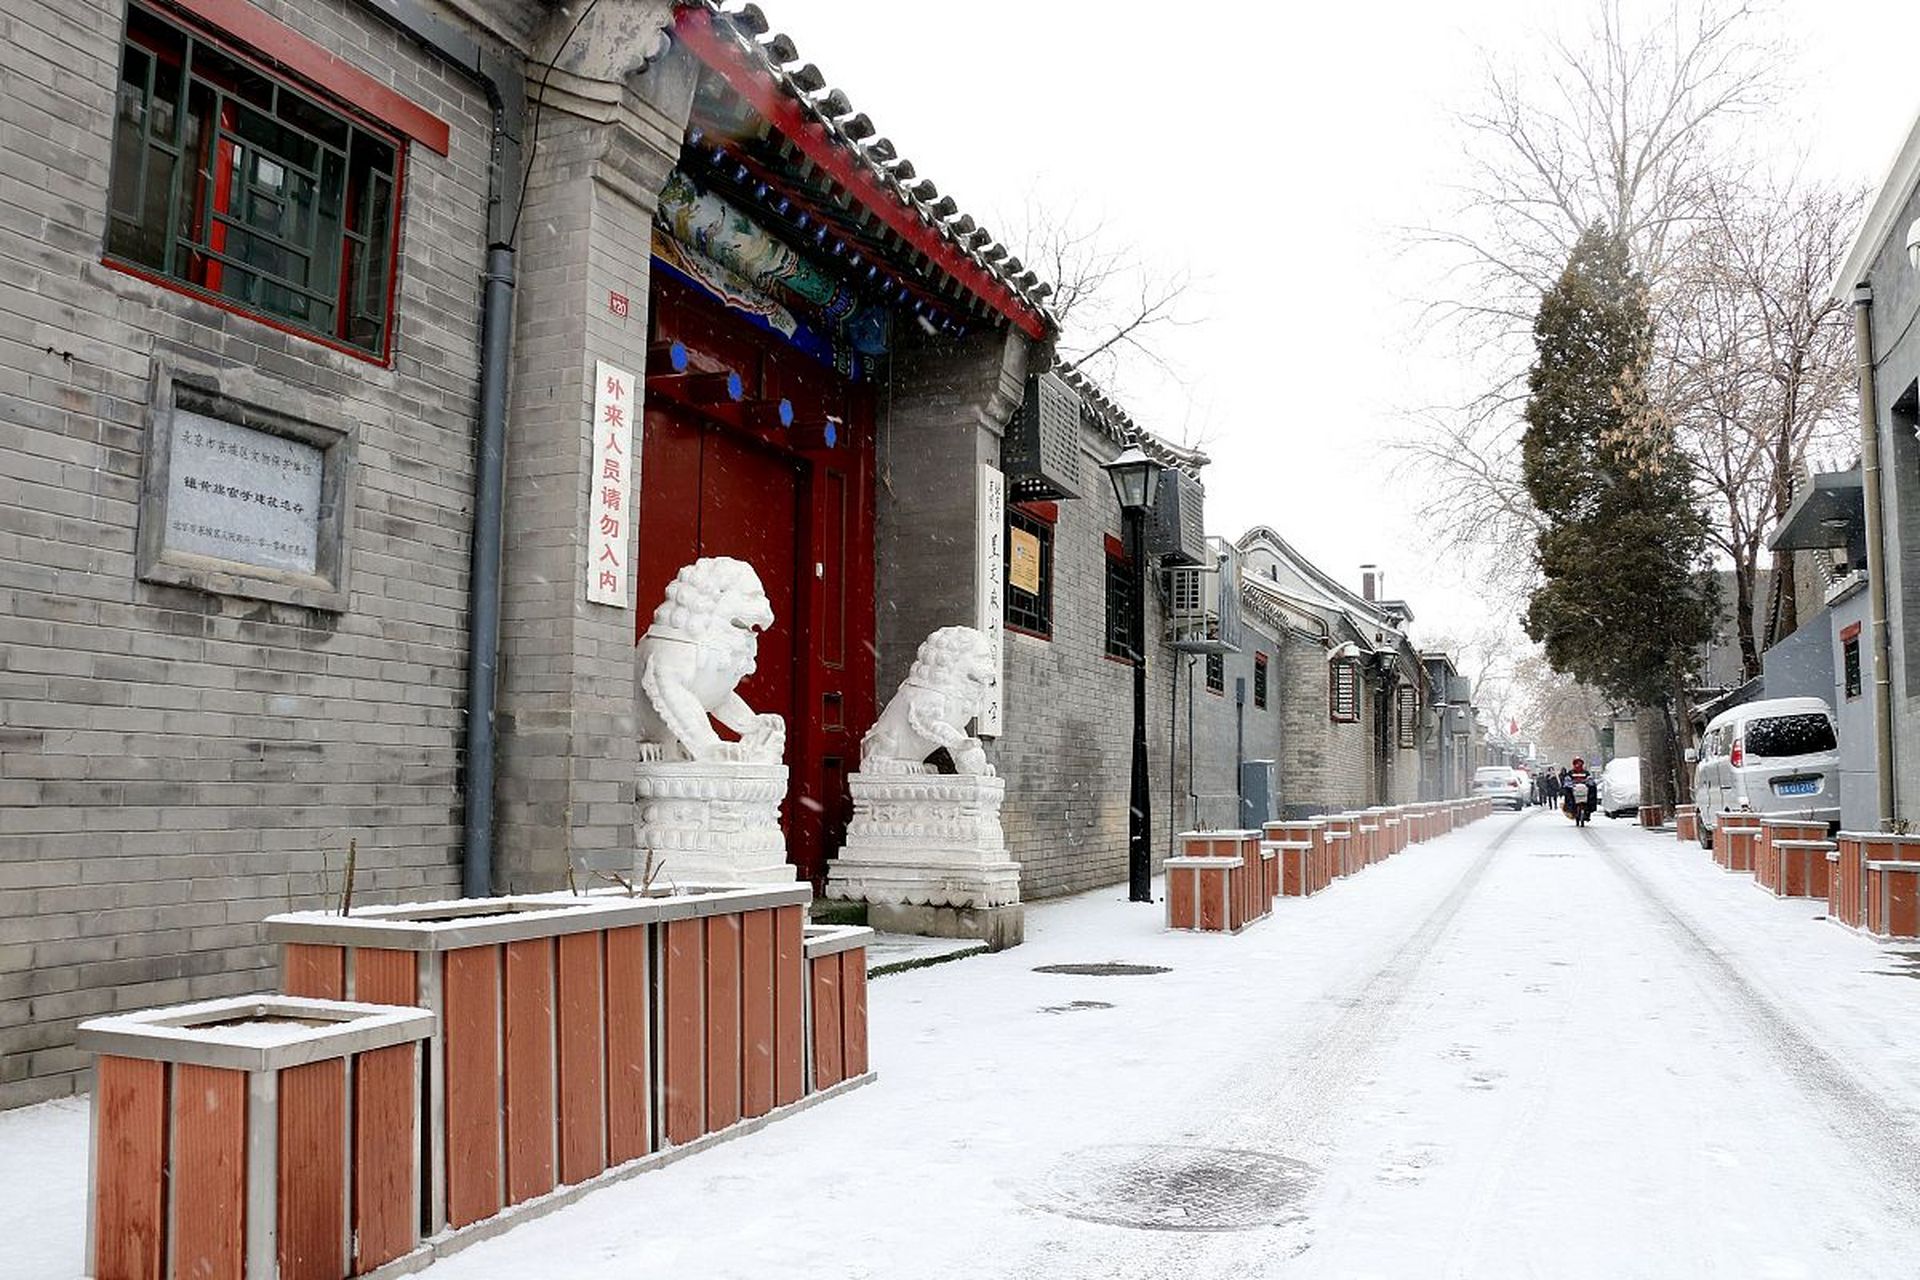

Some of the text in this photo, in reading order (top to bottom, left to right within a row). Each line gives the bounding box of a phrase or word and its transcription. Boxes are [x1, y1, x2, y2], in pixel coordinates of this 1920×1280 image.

[599, 376, 625, 593] 外来人员请勿入内
